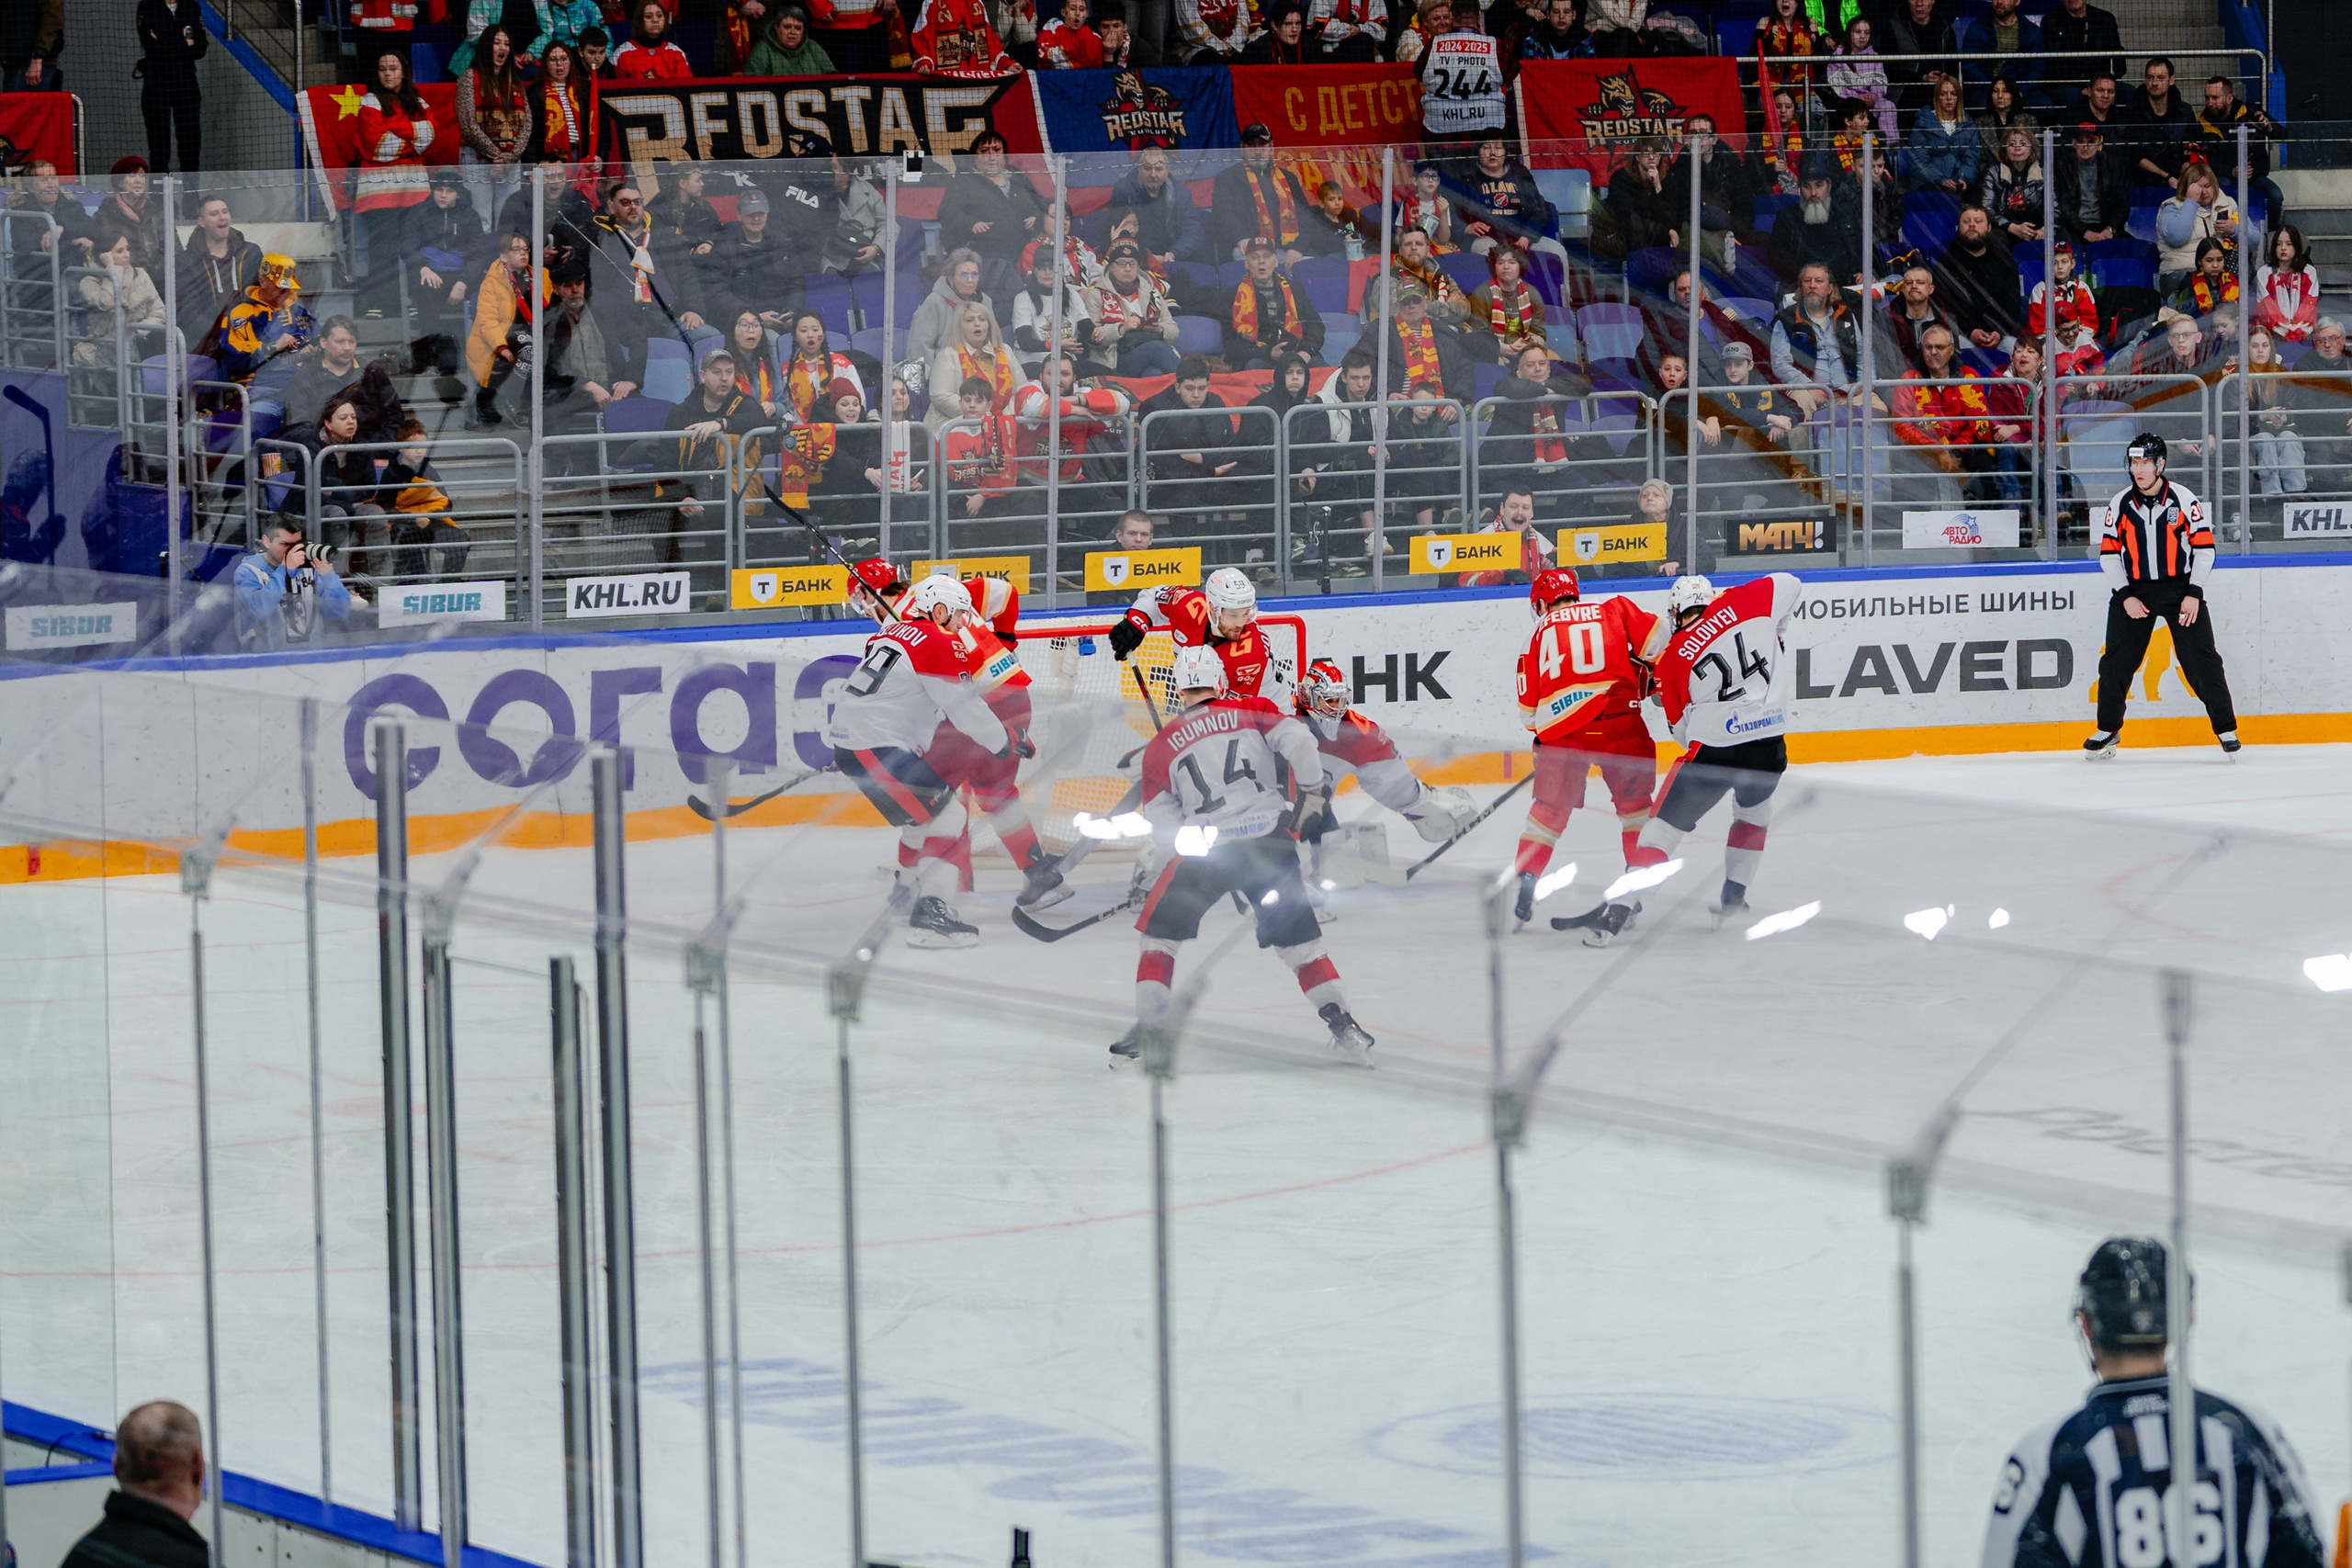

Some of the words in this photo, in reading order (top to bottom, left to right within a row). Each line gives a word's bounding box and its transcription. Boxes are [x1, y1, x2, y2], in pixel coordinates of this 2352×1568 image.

[1440, 56, 1451, 65] TV
[1458, 56, 1487, 65] PHOTO
[1433, 69, 1493, 99] 244
[1284, 87, 1307, 131] С
[1317, 77, 1427, 137] ДЕТСТ
[1442, 107, 1486, 121] KHL.RU
[1102, 110, 1187, 142] REDSTAR
[1580, 118, 1688, 151] REDSTAR
[786, 185, 820, 209] FILA
[1941, 525, 1968, 536] АВТО
[2291, 508, 2352, 532] KHL.
[1603, 536, 1649, 552] БАНК
[1739, 521, 1825, 551] МАТЧ!
[1949, 534, 1983, 545] РАДИО
[1456, 545, 1503, 559] БАНК
[1133, 562, 1182, 576] БАНК
[574, 581, 682, 609] KHL.RU
[782, 579, 832, 593] БАНК
[402, 592, 481, 616] SIBUR
[1692, 593, 1704, 604] 24
[1981, 591, 2075, 613] ШИНЫ
[31, 615, 113, 637] SIBUR
[1678, 605, 1738, 661] SOLOVYEV
[1538, 621, 1606, 681] 40
[1311, 649, 1453, 705] НК
[1691, 631, 1770, 703] 24
[1187, 673, 1200, 686] 14
[1167, 710, 1238, 751] IGUMNOV
[1177, 739, 1266, 815] 14
[2114, 1480, 2225, 1568] 86
